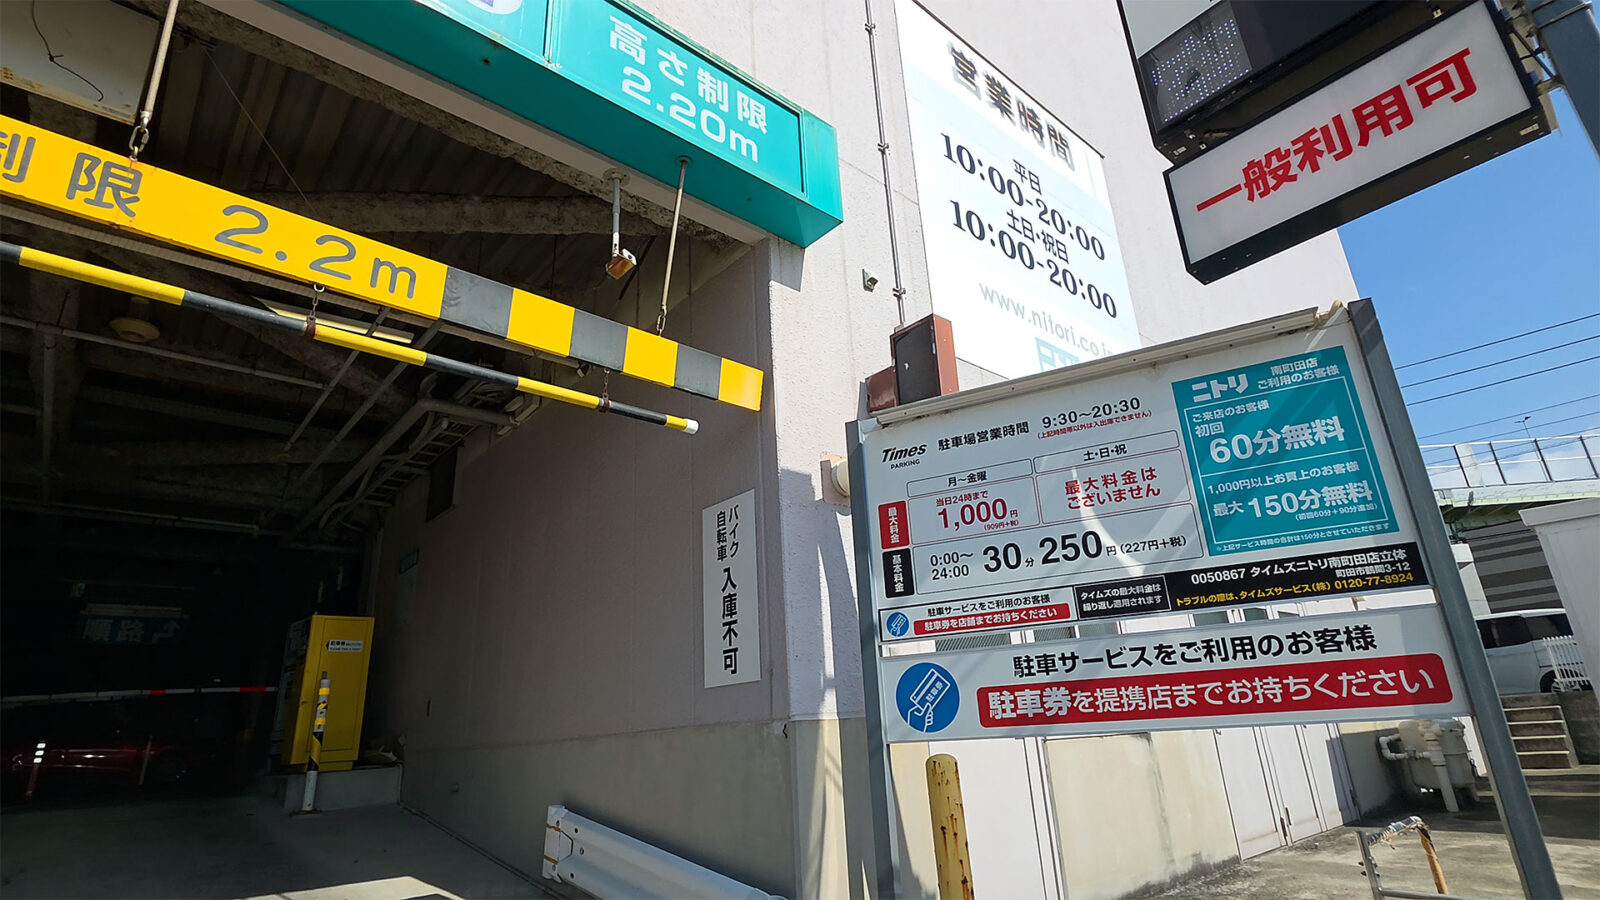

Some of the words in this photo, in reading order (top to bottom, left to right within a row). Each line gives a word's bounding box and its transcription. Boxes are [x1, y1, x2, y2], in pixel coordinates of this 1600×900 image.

[609, 15, 768, 135] 高さ制限
[621, 65, 759, 163] 2.20m
[949, 43, 1075, 172] 営業時間
[1196, 47, 1478, 212] 一般利用可
[1013, 159, 1042, 196] 平日
[940, 132, 1106, 261] 10:00-20:00
[214, 204, 418, 302] 2.2m
[1006, 209, 1070, 265] 土日・祝日
[950, 200, 1117, 319] 10:00-20:00
[1257, 365, 1340, 390] ご利用のお客様
[1270, 357, 1318, 376] 南町田店
[1192, 373, 1249, 403] ニトリ
[1192, 399, 1270, 423] ご来店のお客様
[1195, 421, 1225, 438] 初回
[882, 443, 928, 463] Times
[938, 420, 1030, 452] 駐車場営業時間
[1083, 443, 1128, 462] 土・日・祝
[1209, 415, 1345, 464] 60分無料
[890, 458, 920, 470] PARKING
[1064, 466, 1158, 496] 最大料金は
[1207, 460, 1360, 495] 1,000円以上お買上のお客様
[936, 490, 989, 507] 当日24時まで
[1067, 483, 1161, 510] ございません
[1213, 500, 1245, 517] 最大
[1247, 480, 1373, 518] 150分無料
[716, 510, 728, 562] 自転車
[728, 504, 740, 559] バイク
[887, 506, 900, 545] 最大料金
[892, 554, 905, 593] 基本料金
[931, 564, 970, 581] 24:00
[1191, 568, 1246, 585] 0050867
[1250, 548, 1408, 578] タイムズニトリ南町田店立体
[1334, 572, 1414, 590] 0120-77-8924
[927, 593, 1051, 618] 駐車サービスをご利用のお客様
[1080, 583, 1162, 601] タイムズの最大料金は
[721, 566, 739, 675] 入庫不可
[1012, 624, 1378, 678] 駐車サービスをご利用のお客様
[987, 669, 1435, 721] 駐車券を提携店までお持ちください
